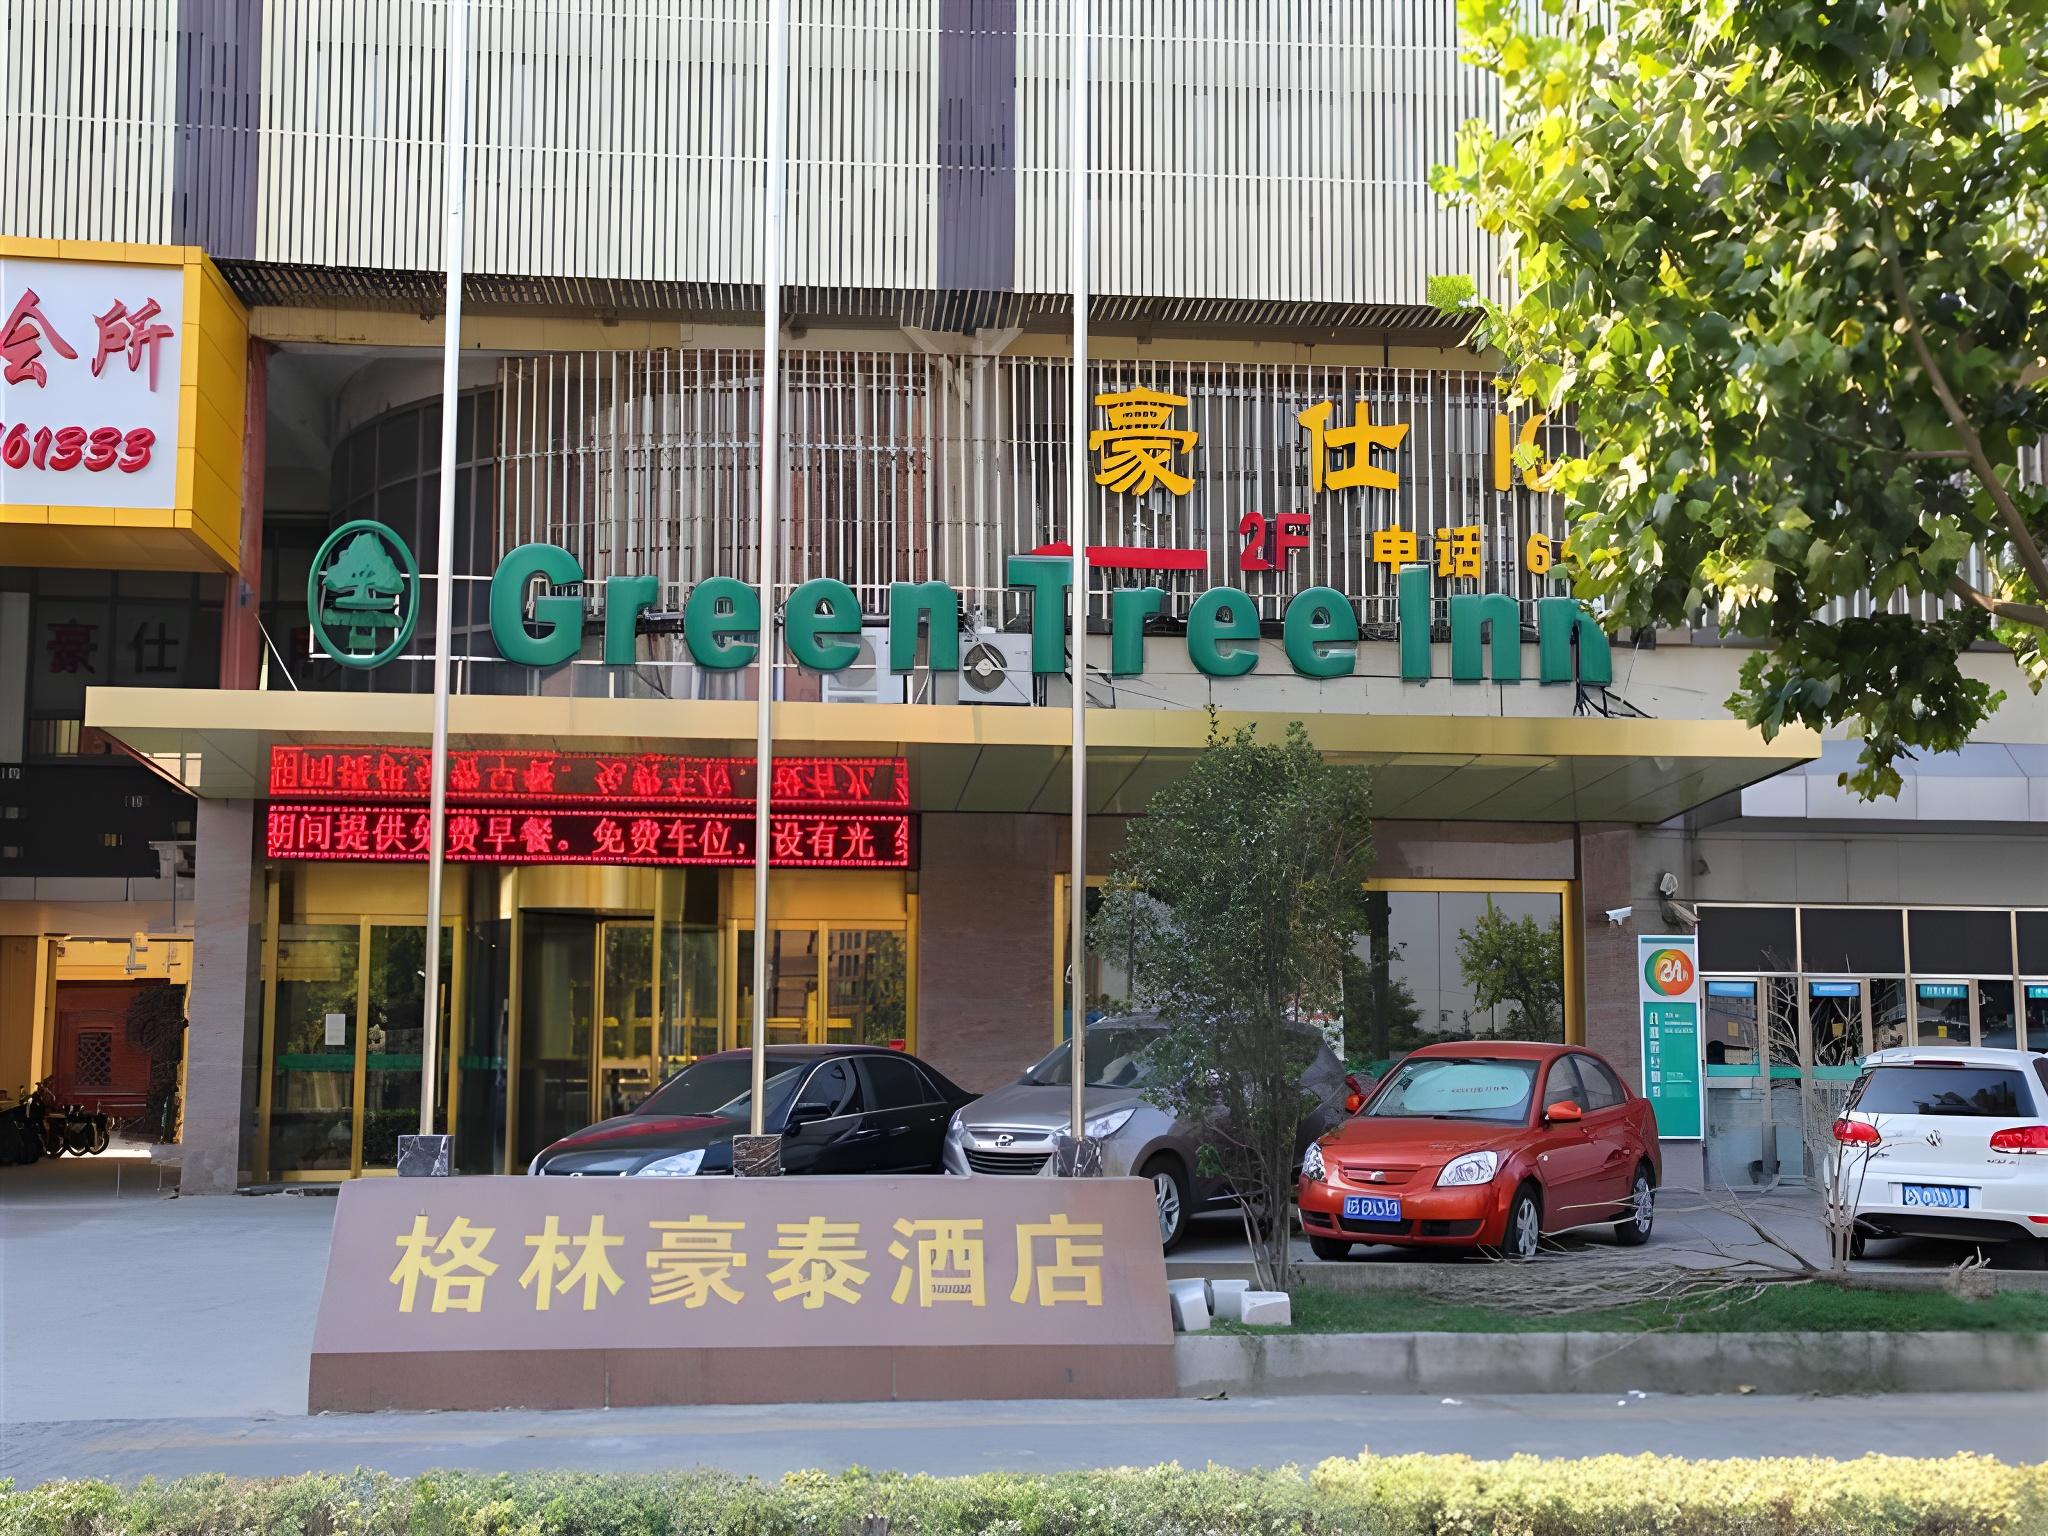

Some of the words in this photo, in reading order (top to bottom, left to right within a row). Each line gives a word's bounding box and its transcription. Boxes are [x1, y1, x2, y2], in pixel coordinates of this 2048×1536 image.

[0, 287, 174, 392] 会所
[1239, 511, 1310, 572] 2F
[490, 542, 959, 675] Green
[1008, 553, 1360, 678] Tree
[1401, 565, 1613, 687] Inn
[389, 1213, 1104, 1313] 格林豪泰酒店
